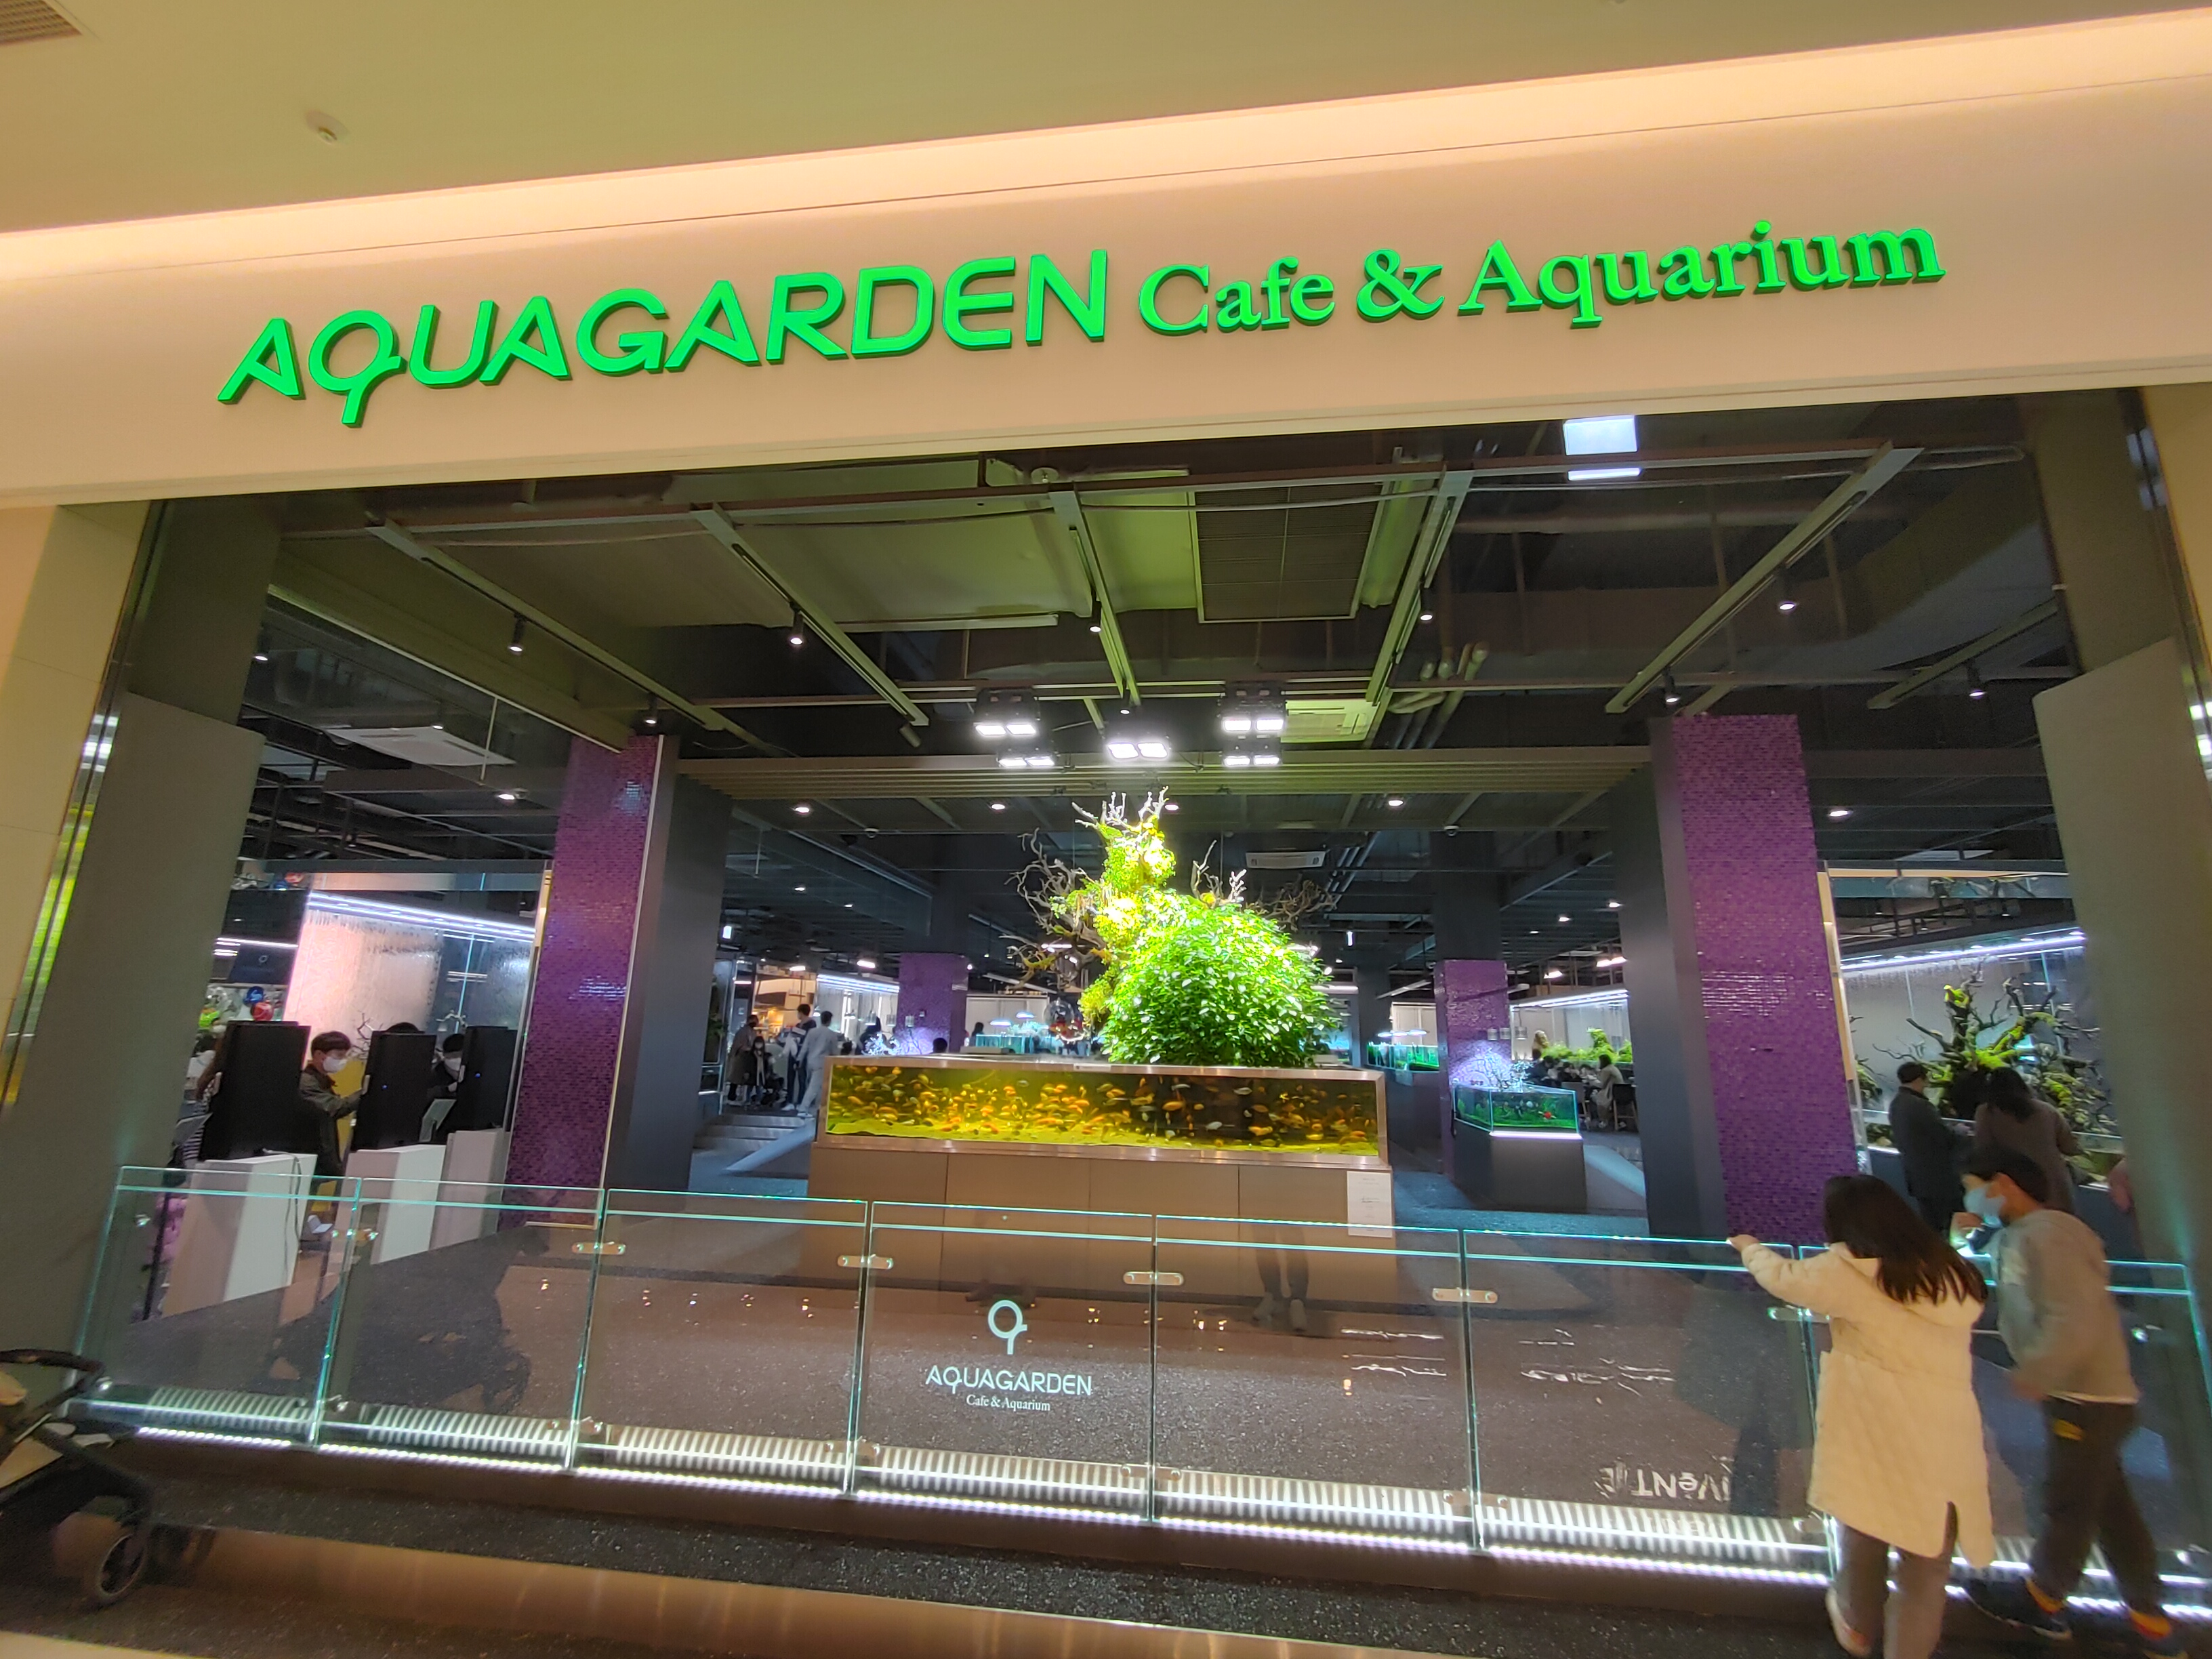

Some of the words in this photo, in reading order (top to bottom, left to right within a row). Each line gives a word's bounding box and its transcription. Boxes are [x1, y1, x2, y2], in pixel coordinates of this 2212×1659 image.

[217, 249, 1109, 426] AQUAGARDEN
[1138, 256, 1336, 336] Cafe
[1356, 249, 1445, 323] &
[1458, 220, 1947, 329] Aquarium
[926, 1365, 1091, 1395] AQUAGARDEN
[966, 1394, 989, 1407] Cafe
[991, 1397, 1000, 1408] &
[1002, 1397, 1050, 1412] Aquarium
